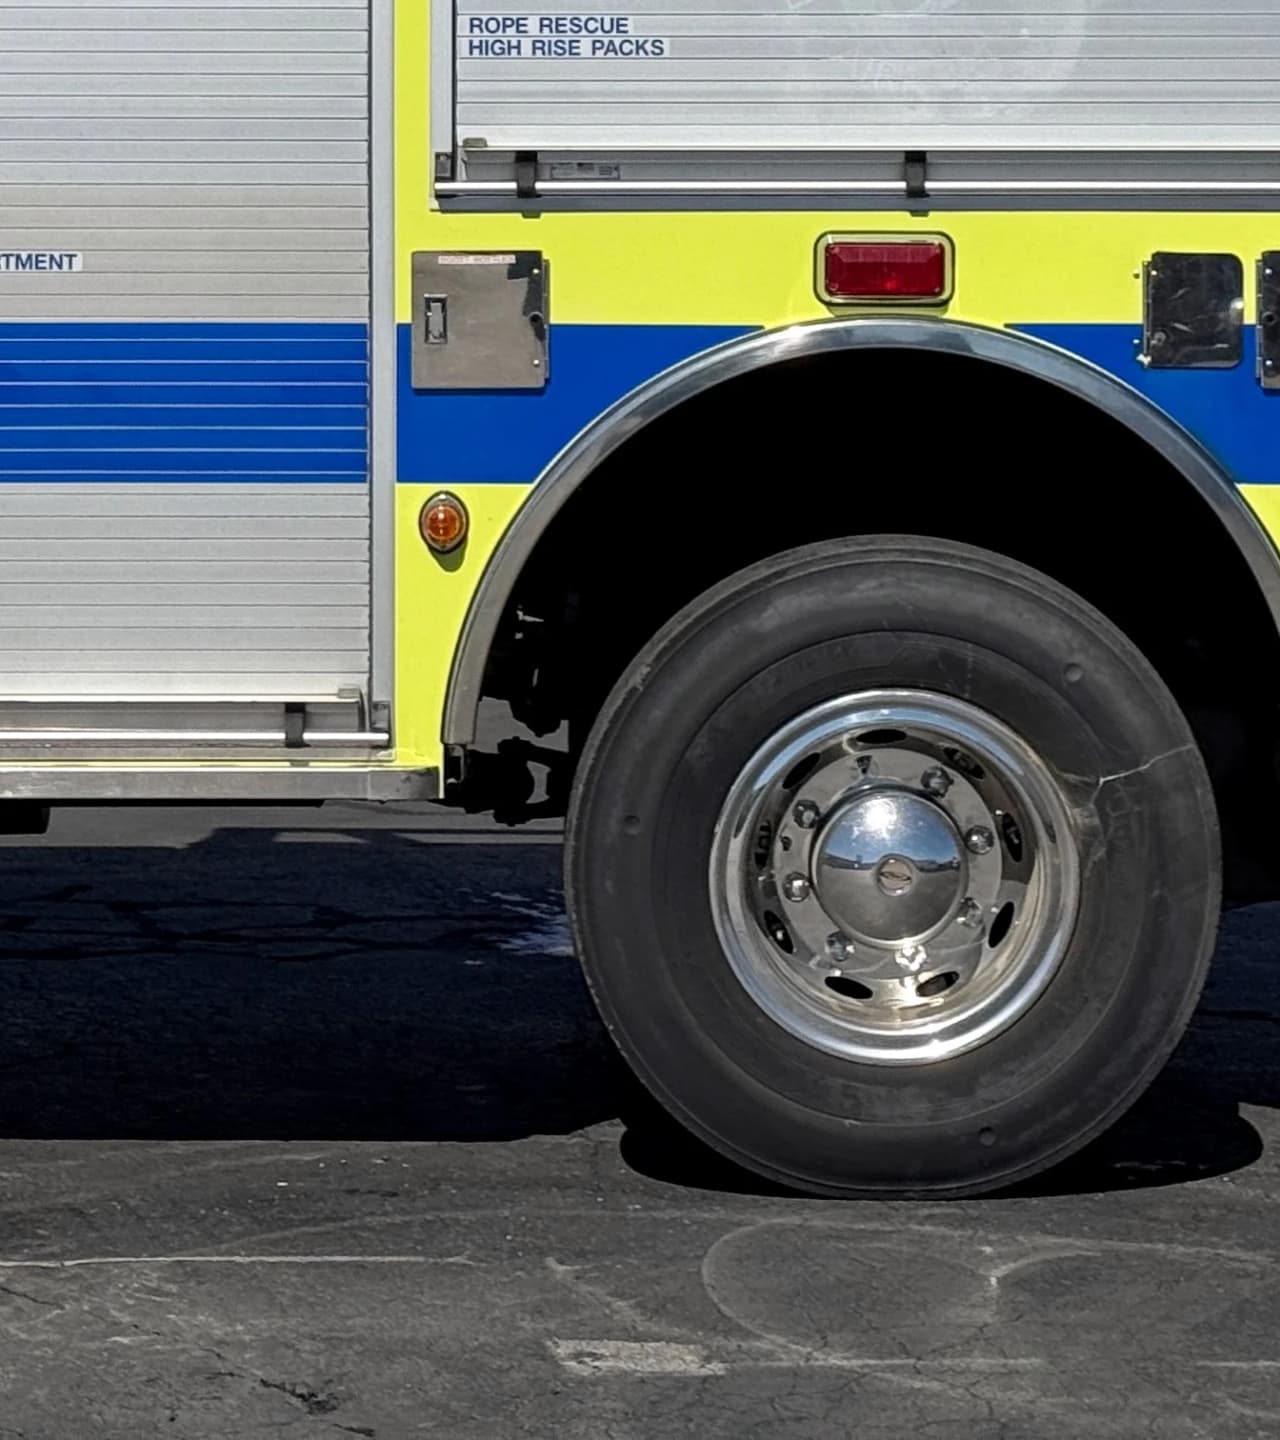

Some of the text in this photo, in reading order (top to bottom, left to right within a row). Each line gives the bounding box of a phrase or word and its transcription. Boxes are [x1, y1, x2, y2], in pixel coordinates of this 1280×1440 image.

[468, 16, 630, 34] ROPE RESCUE
[468, 39, 665, 56] HIGH RISE PACKS
